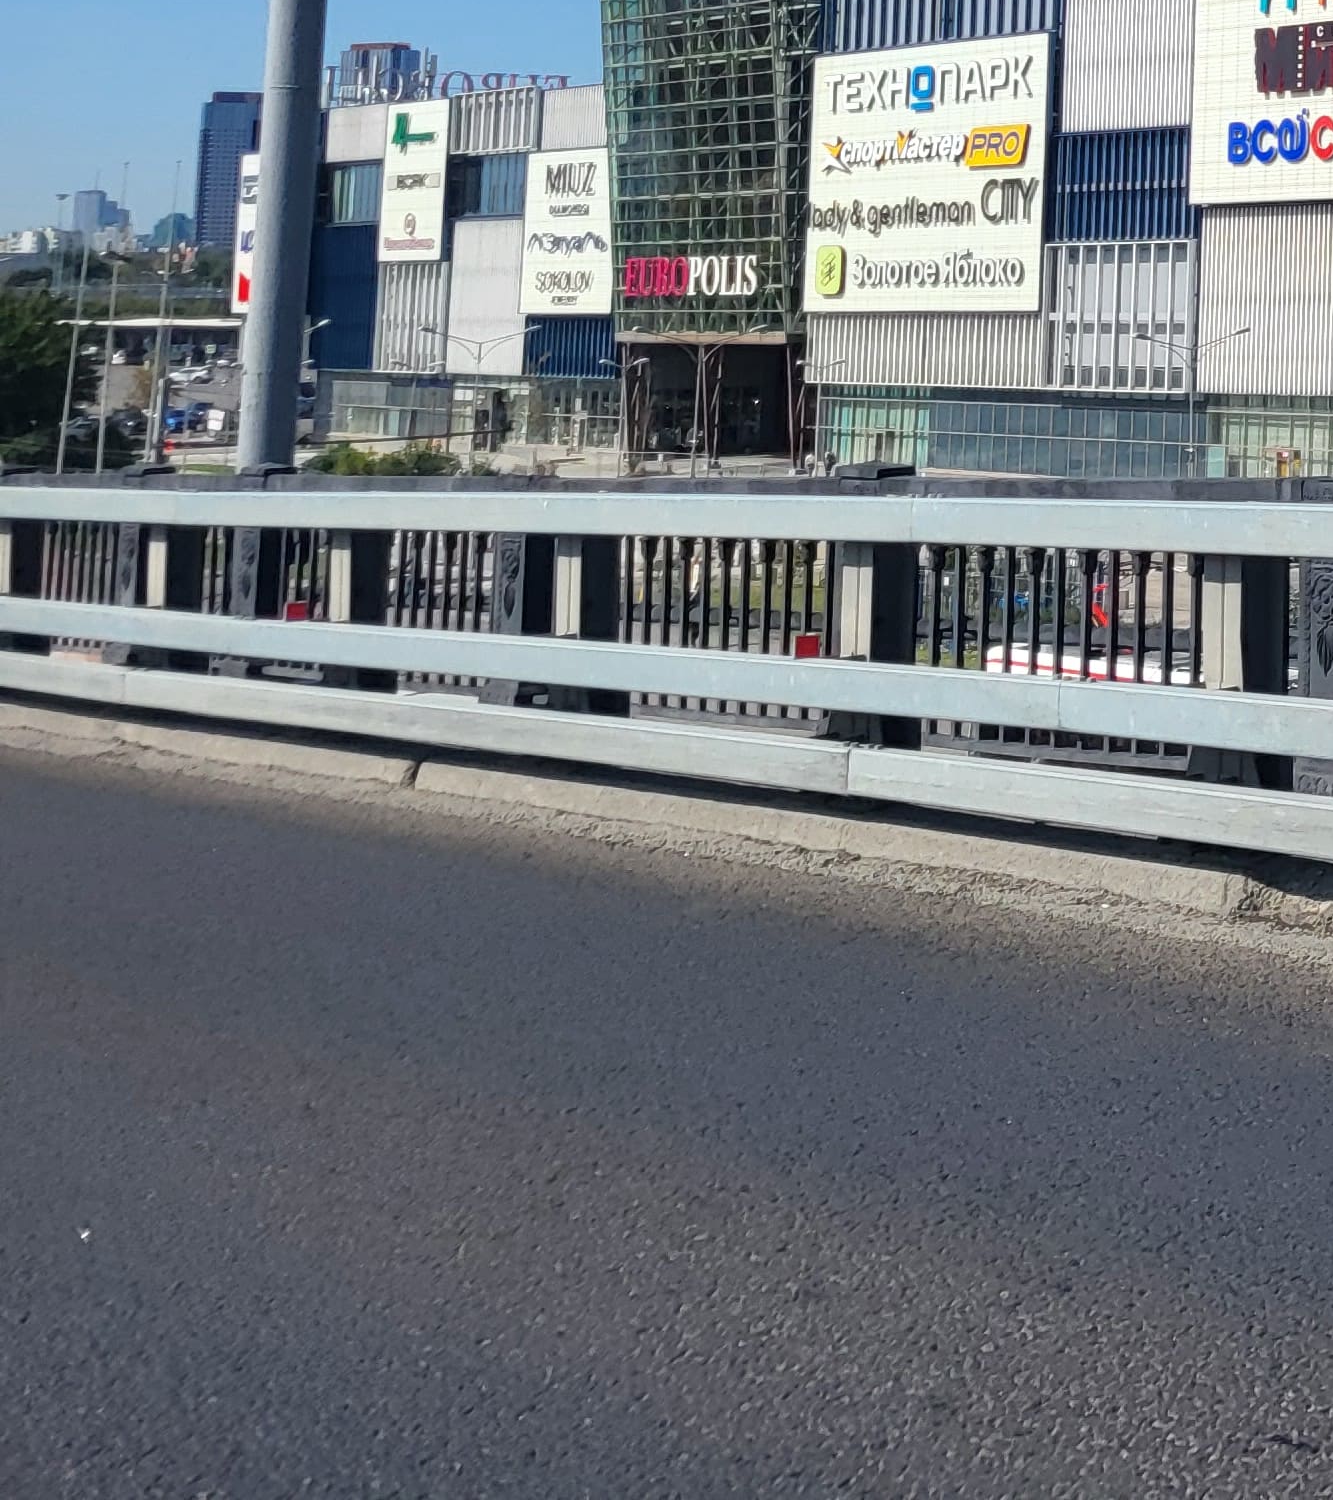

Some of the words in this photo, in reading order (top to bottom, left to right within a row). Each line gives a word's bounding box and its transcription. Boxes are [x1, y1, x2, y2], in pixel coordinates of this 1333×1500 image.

[824, 55, 1034, 114] ТЕХНОПАРК
[969, 131, 1021, 159] PRO
[545, 162, 597, 198] MIUZ
[807, 200, 849, 237] lady
[850, 199, 865, 229] &
[867, 197, 975, 238] gentleman
[981, 177, 1039, 225] CITY
[535, 270, 594, 293] SOKOLOV
[624, 254, 758, 298] EUROPOLIS
[851, 254, 941, 288] Золотое
[941, 249, 1024, 287] Яблоко
